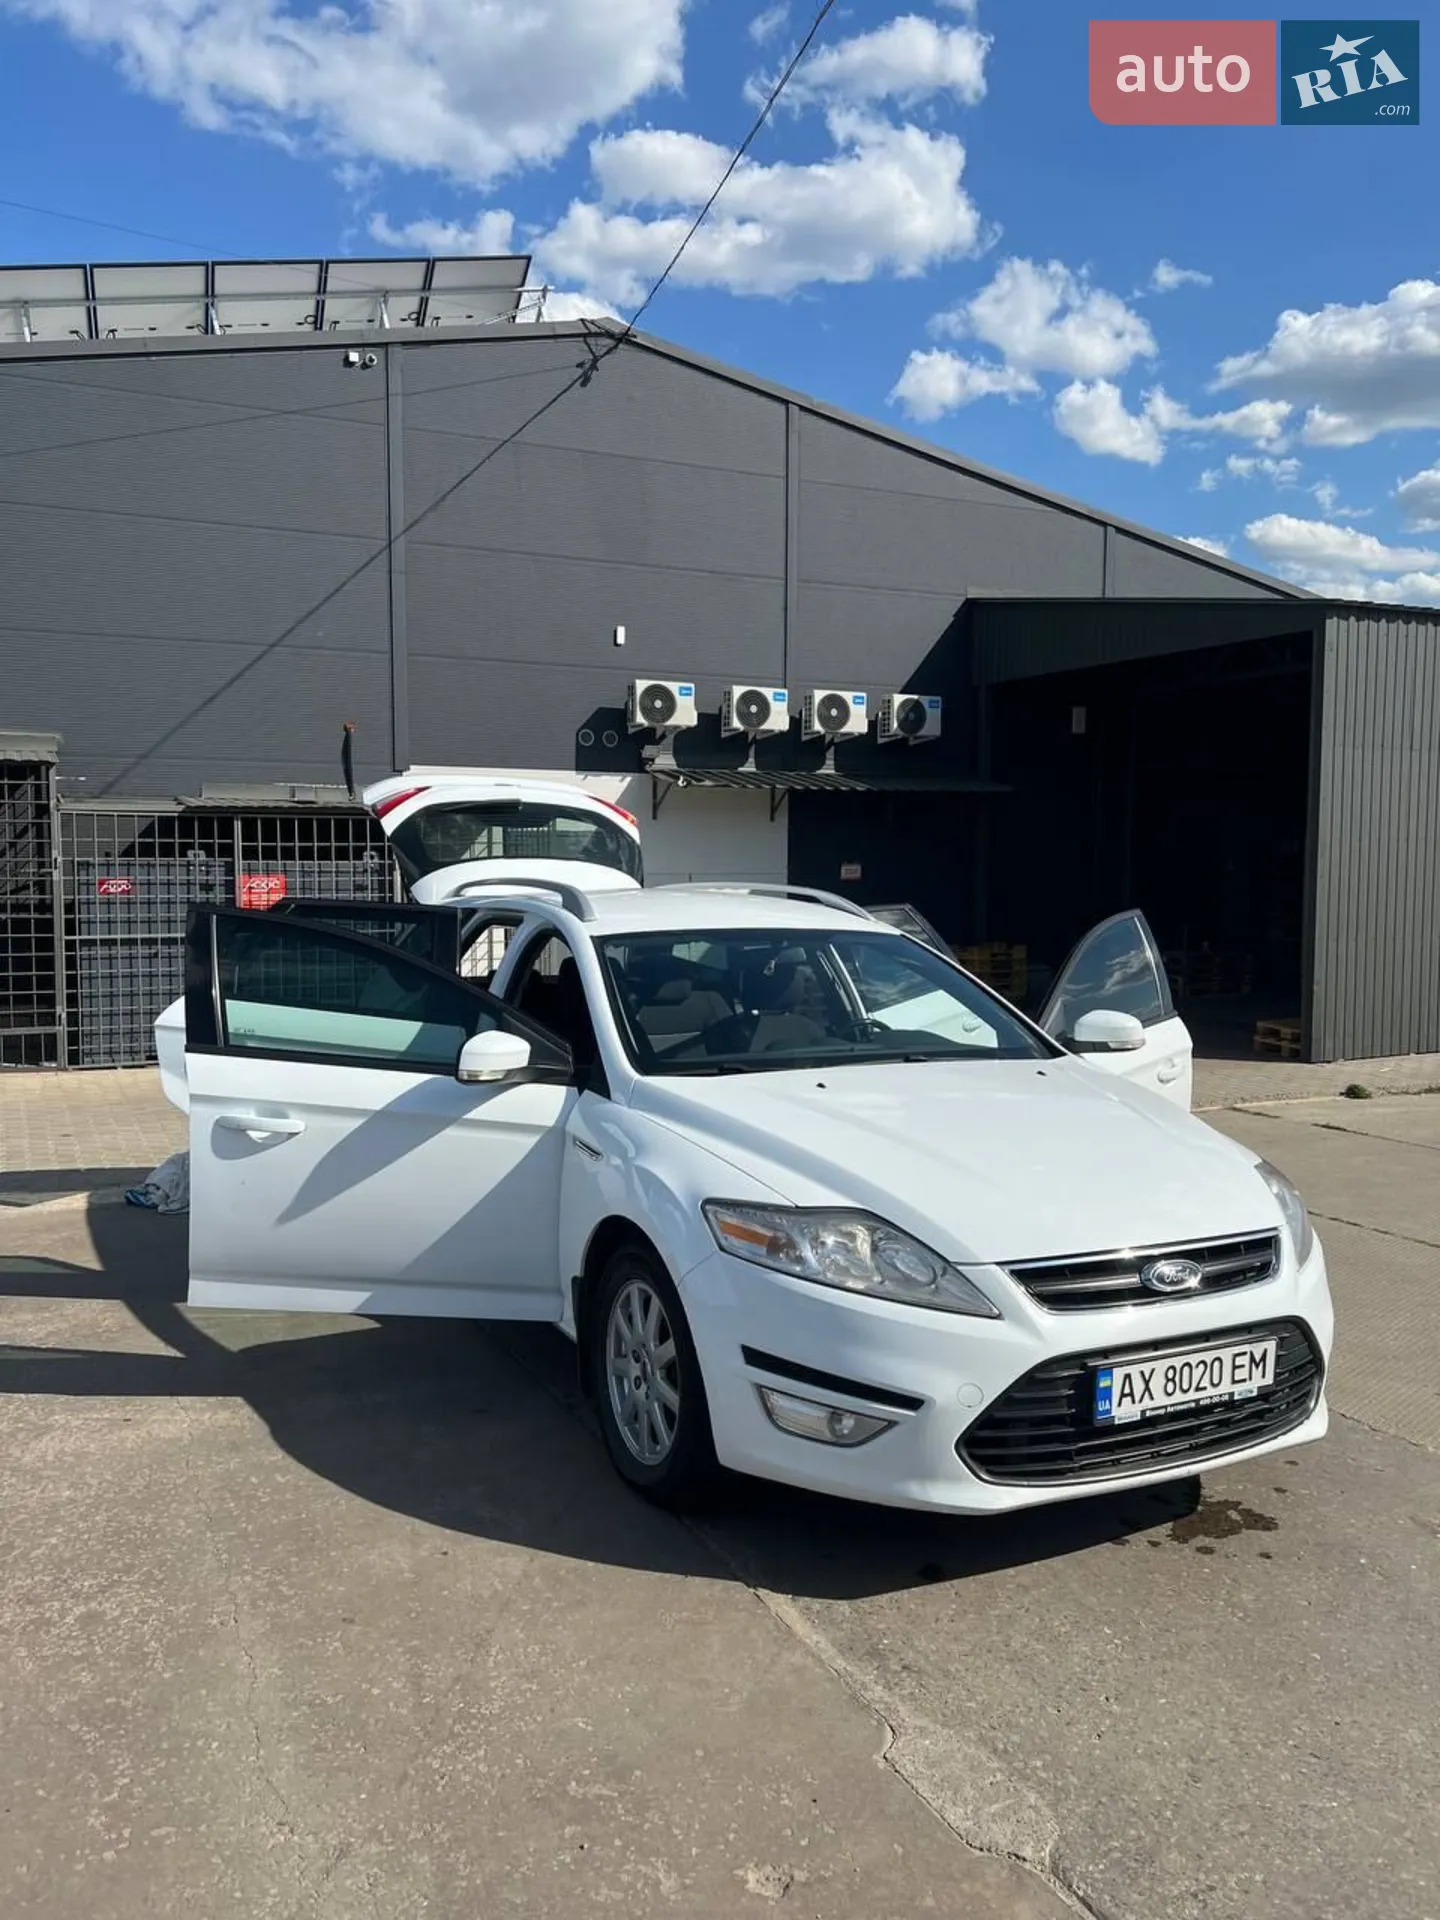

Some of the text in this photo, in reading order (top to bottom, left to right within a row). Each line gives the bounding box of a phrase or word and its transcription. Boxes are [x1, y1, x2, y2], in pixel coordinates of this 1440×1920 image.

[1164, 1266, 1189, 1283] Ford
[1117, 1368, 1156, 1408] AX
[1163, 1355, 1224, 1398] 8020
[1231, 1347, 1268, 1385] EM
[1098, 1401, 1112, 1413] UA
